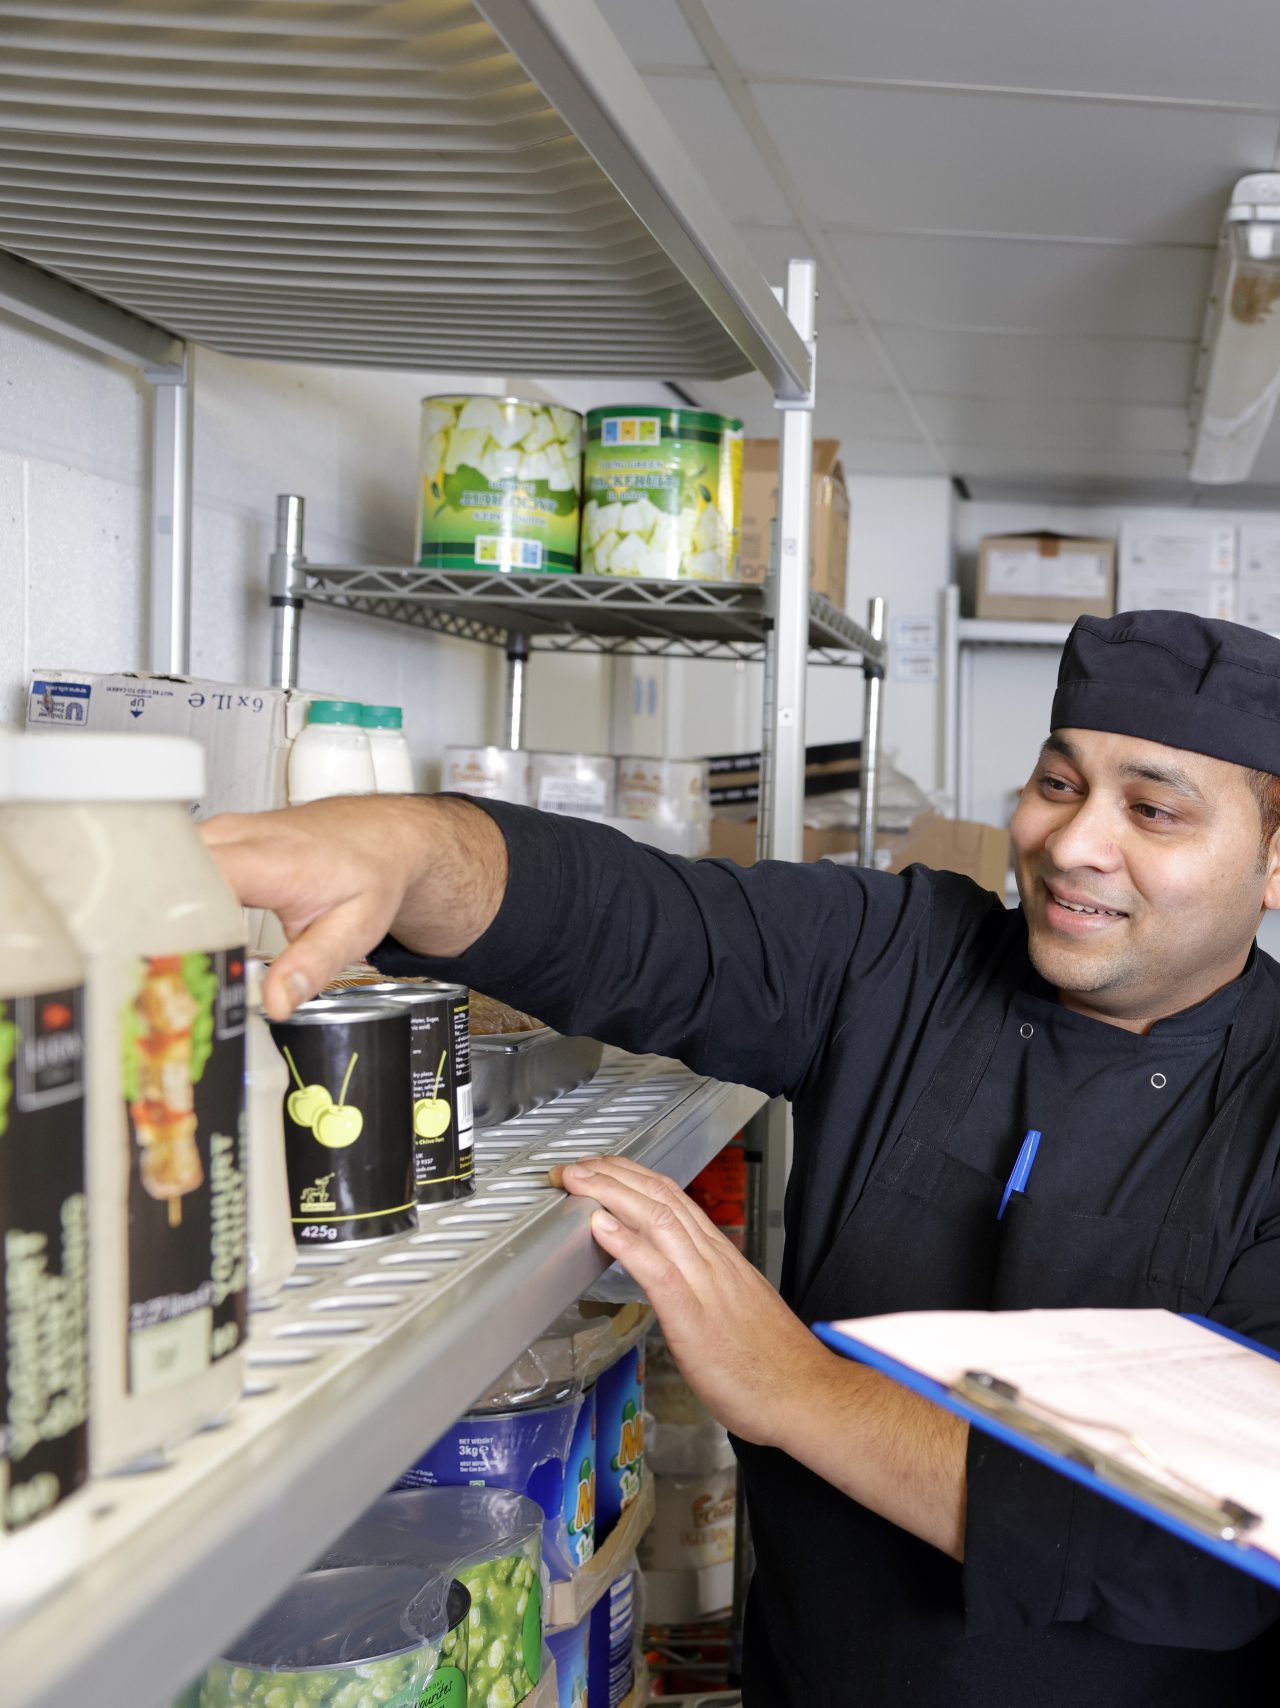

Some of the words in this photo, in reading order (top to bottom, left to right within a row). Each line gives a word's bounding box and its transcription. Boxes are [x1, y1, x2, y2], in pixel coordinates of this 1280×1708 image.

[130, 698, 145, 708] UP
[237, 695, 248, 707] x
[252, 697, 263, 713] 6
[301, 1225, 338, 1240] 425g
[458, 1445, 478, 1457] 3kg
